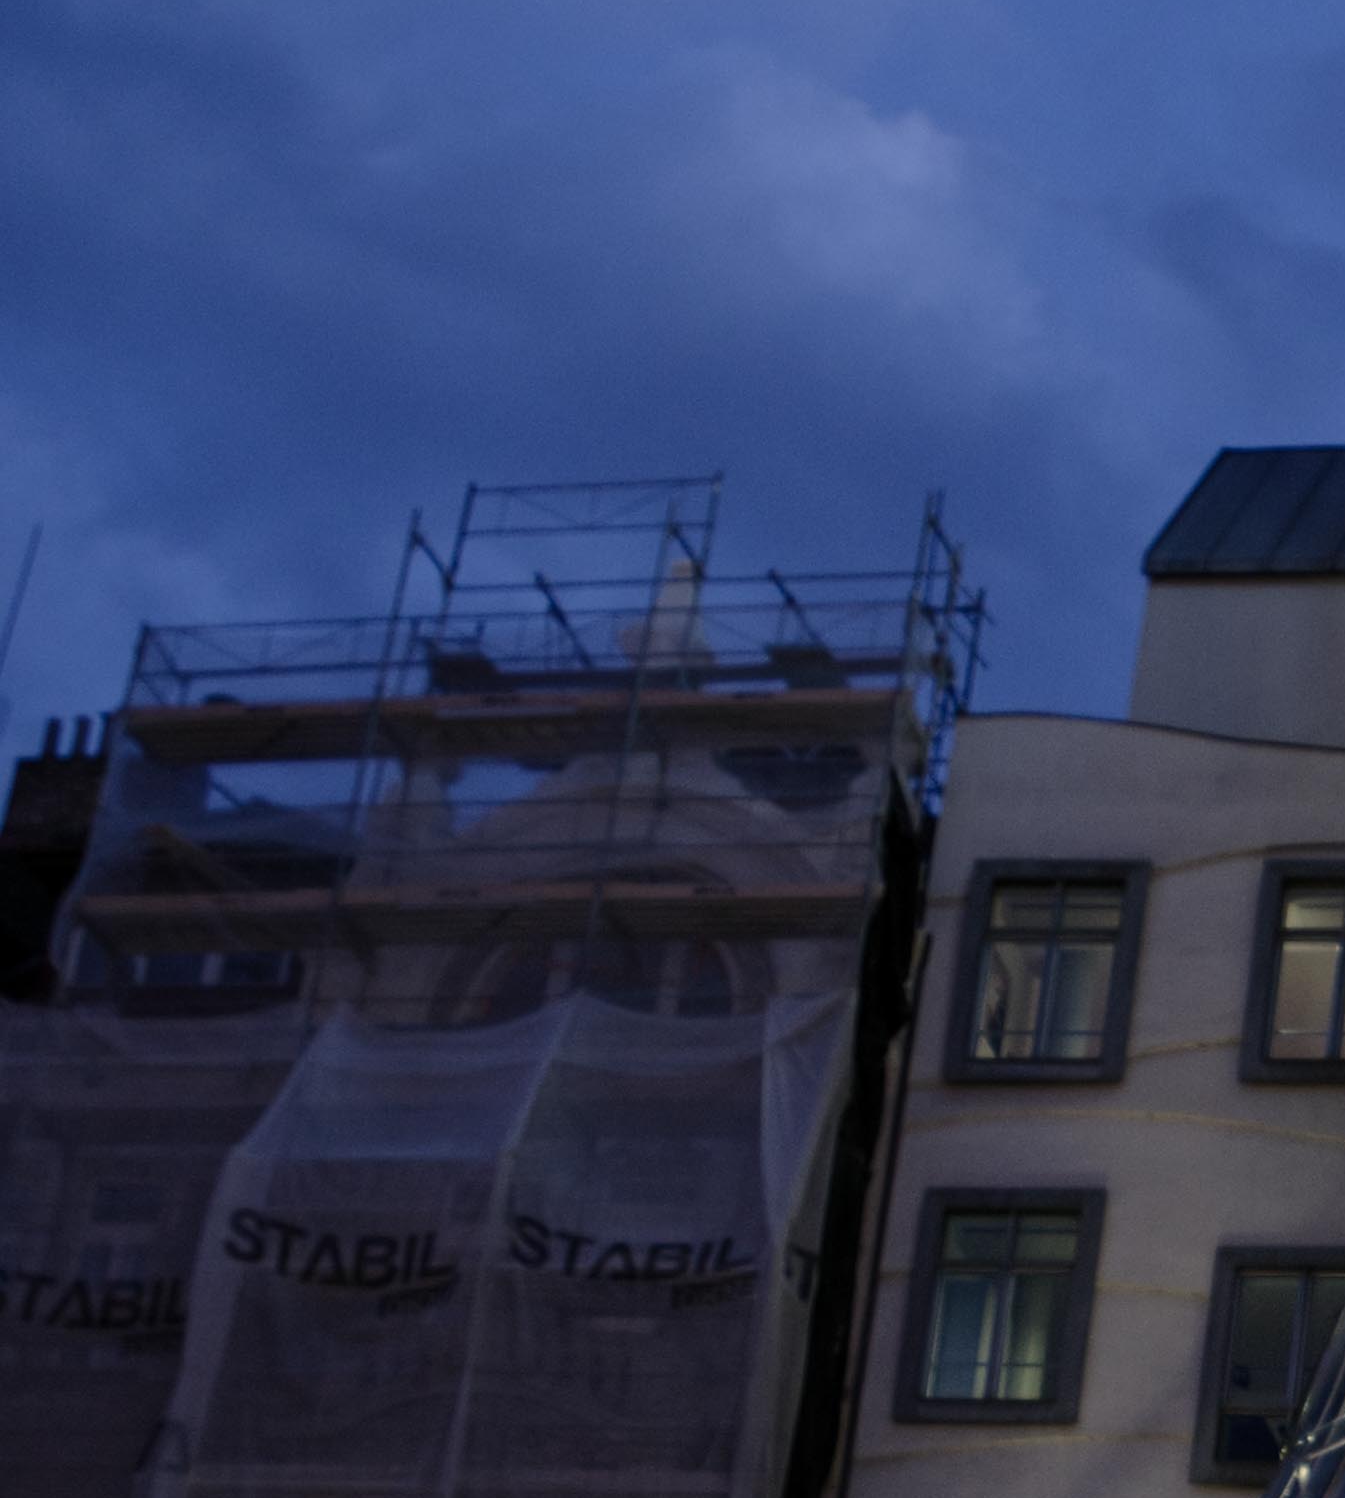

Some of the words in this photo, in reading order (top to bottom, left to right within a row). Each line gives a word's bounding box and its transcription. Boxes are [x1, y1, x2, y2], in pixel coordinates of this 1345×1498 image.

[223, 1208, 457, 1287] STABIL
[509, 1216, 758, 1282] STABIL
[0, 1268, 188, 1329] TABIL
